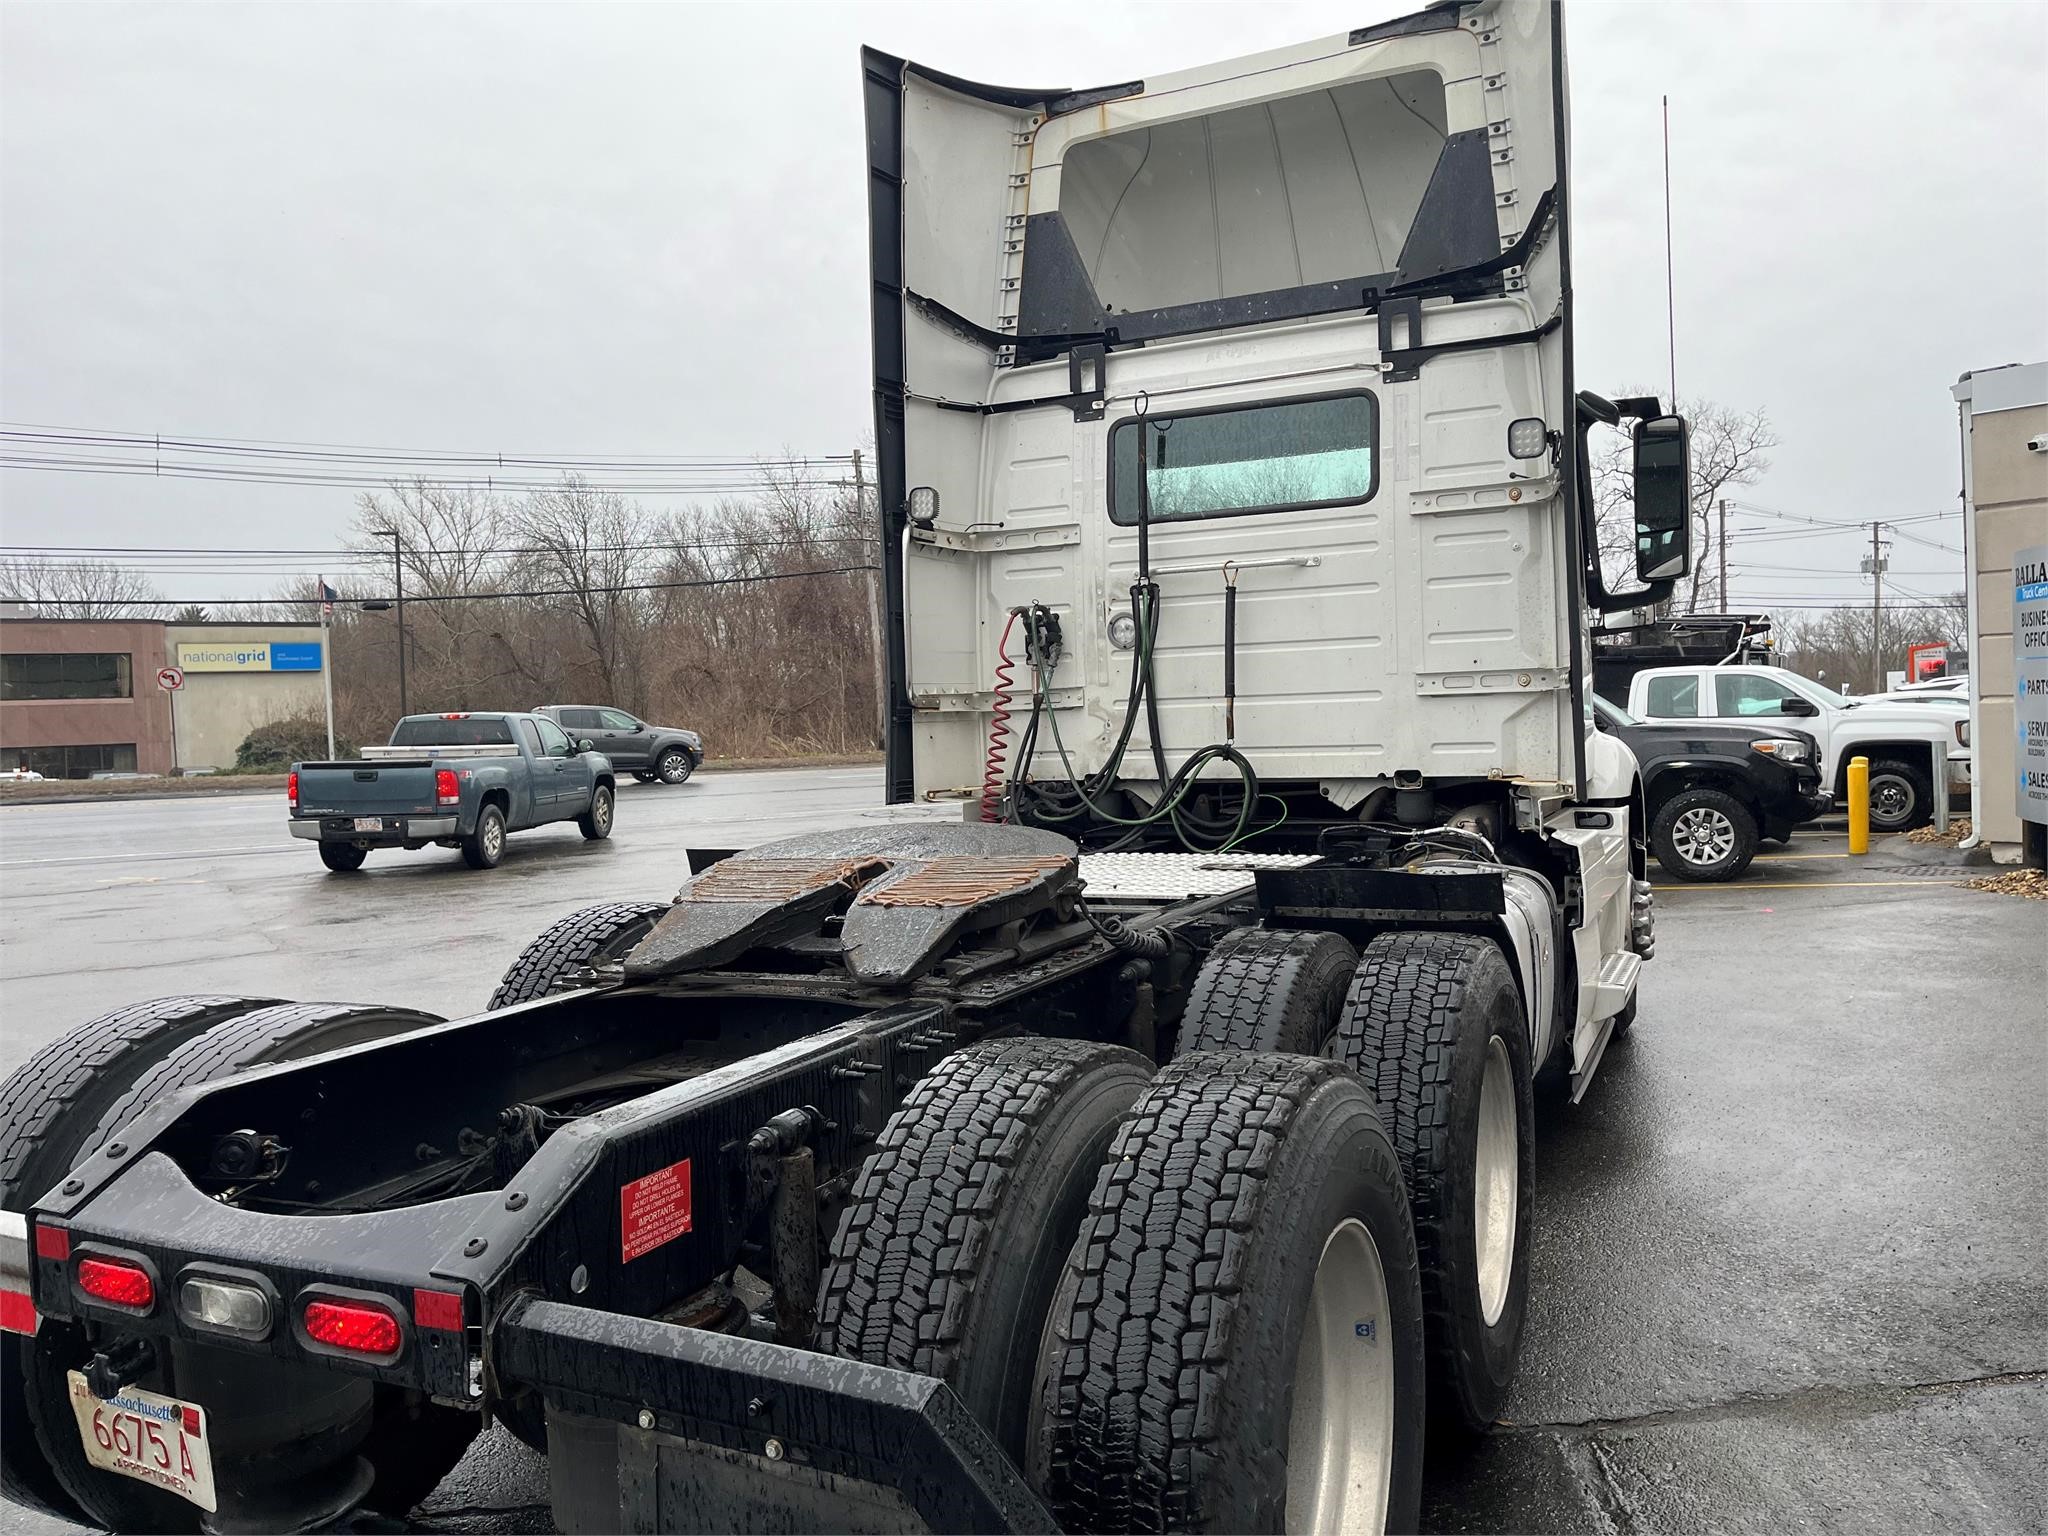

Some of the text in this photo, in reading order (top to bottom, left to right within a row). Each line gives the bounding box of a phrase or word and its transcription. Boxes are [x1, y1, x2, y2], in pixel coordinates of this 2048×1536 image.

[2015, 562, 2048, 587] BALLA
[2022, 587, 2034, 599] Truck
[183, 649, 266, 665] nationalgrid
[639, 1167, 674, 1190] IMPORTANT
[640, 1197, 650, 1207] NOT
[638, 1203, 676, 1227] IMPORTANTE
[106, 1396, 176, 1423] assachusetts
[93, 1406, 197, 1482] 6675 A
[116, 1455, 188, 1493] APPORTIONED
